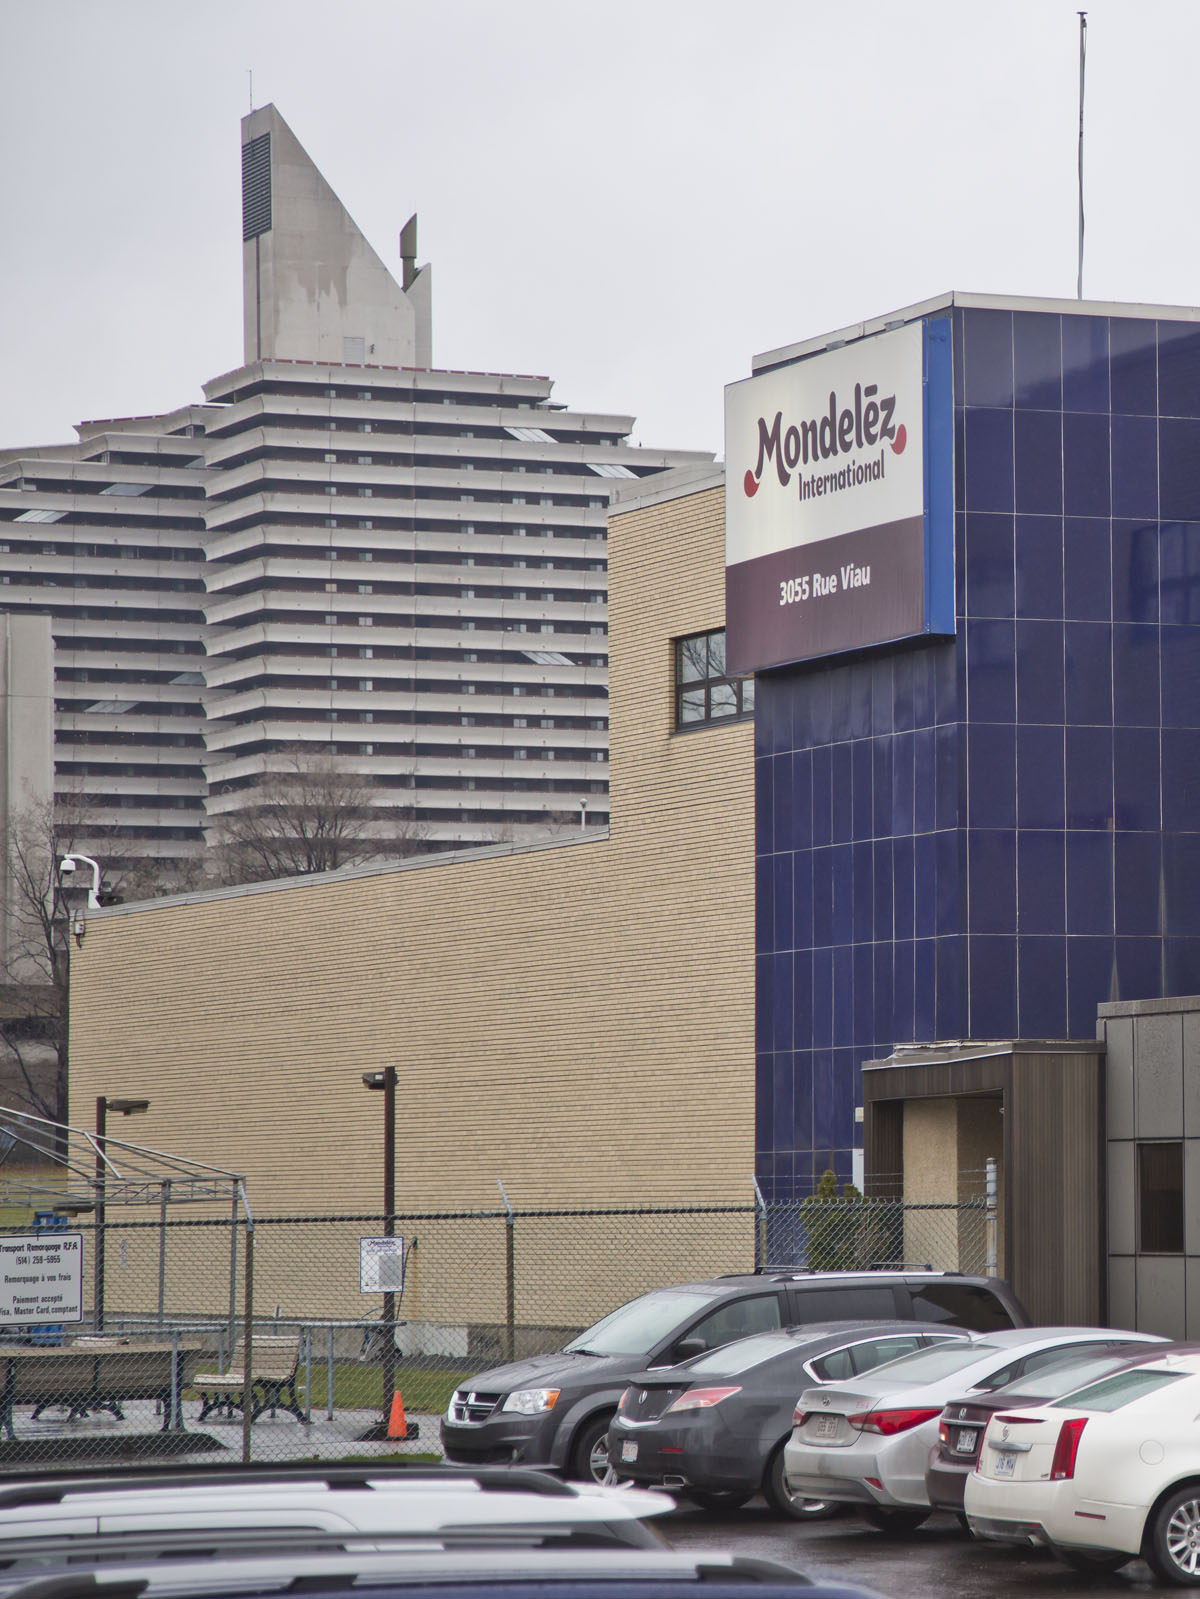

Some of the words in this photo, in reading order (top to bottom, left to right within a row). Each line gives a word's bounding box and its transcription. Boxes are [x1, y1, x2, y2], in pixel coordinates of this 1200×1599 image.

[755, 382, 896, 487] Mondelēz
[798, 448, 885, 501] International
[779, 575, 809, 606] 3055
[812, 572, 837, 597] Rue
[840, 563, 871, 590] Viau
[27, 1243, 61, 1252] Remorquage
[4, 1275, 39, 1284] Remorquage
[58, 1273, 72, 1281] frais
[12, 1296, 39, 1304] Paiement
[41, 1294, 63, 1303] accepté
[14, 1307, 34, 1315] Master
